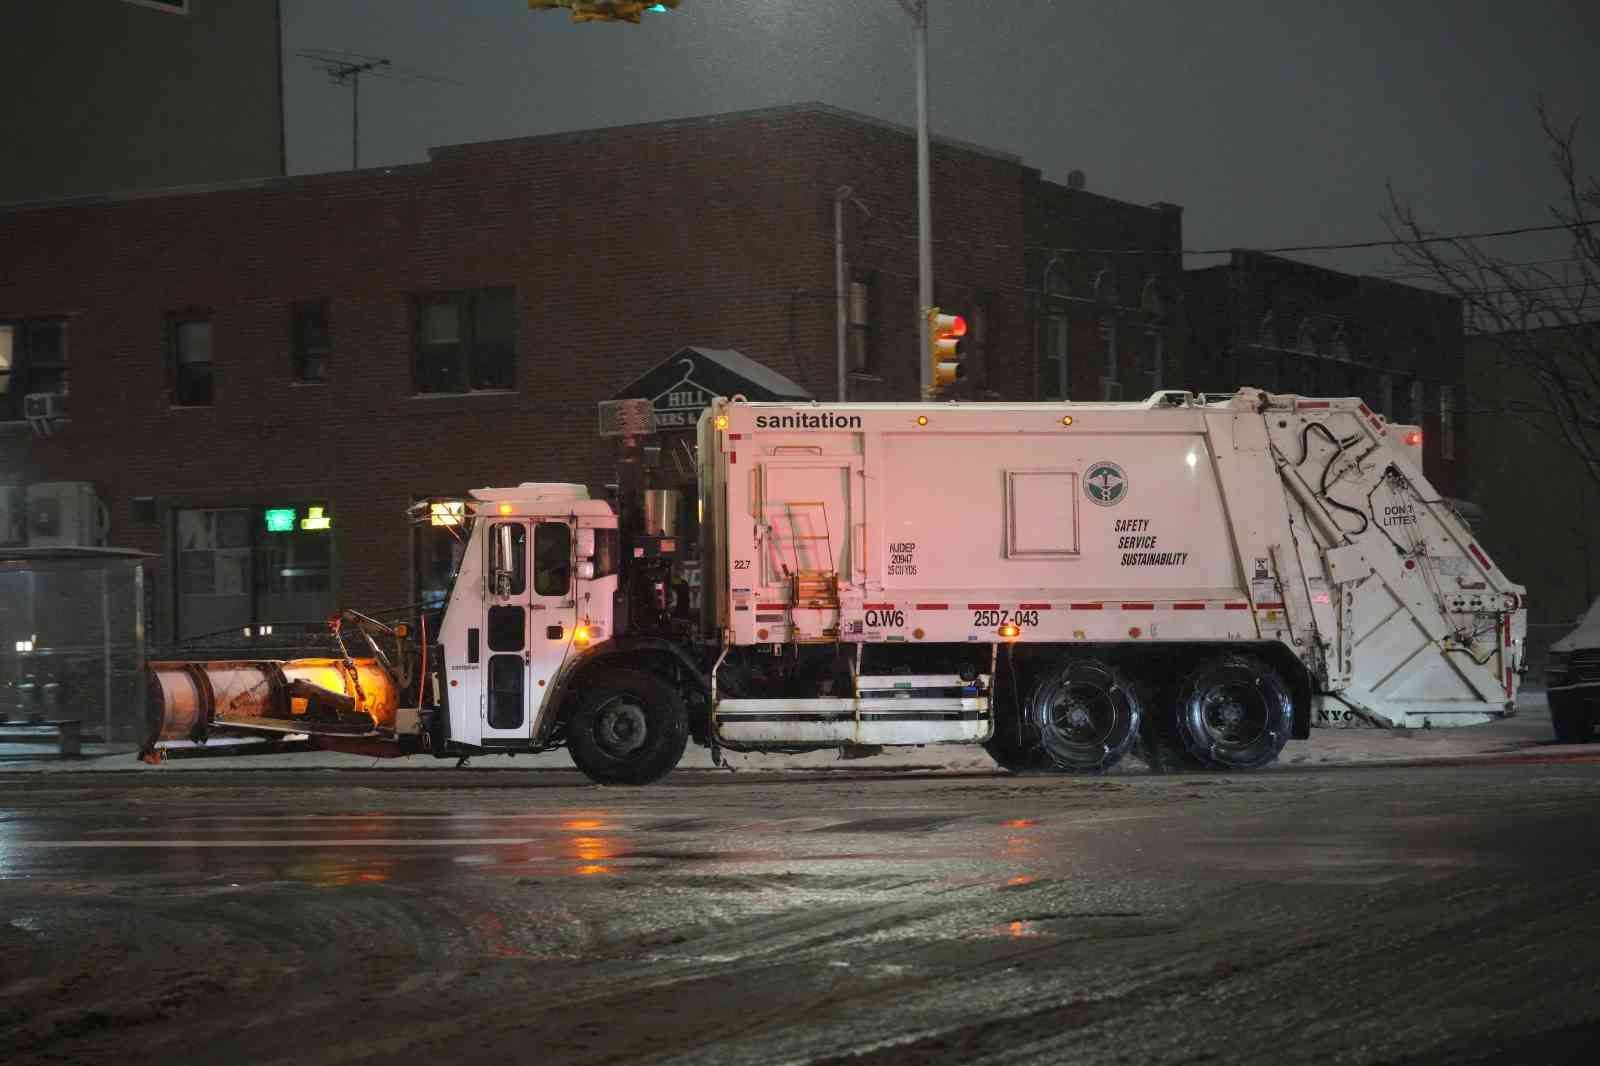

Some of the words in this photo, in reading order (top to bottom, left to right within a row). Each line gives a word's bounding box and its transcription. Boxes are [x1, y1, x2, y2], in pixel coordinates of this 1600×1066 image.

[669, 390, 705, 407] HILL
[756, 412, 862, 428] sanitation
[1114, 519, 1150, 532] SAFETY
[1384, 515, 1417, 526] LITTER
[889, 543, 916, 553] NJDEP
[1118, 536, 1157, 549] SERVICE
[734, 560, 750, 569] 22.7
[891, 554, 913, 564] 20947
[1121, 553, 1188, 566] SUSTAINABILITY
[865, 610, 905, 628] Q.W6
[974, 610, 1040, 627] 25DZ-043
